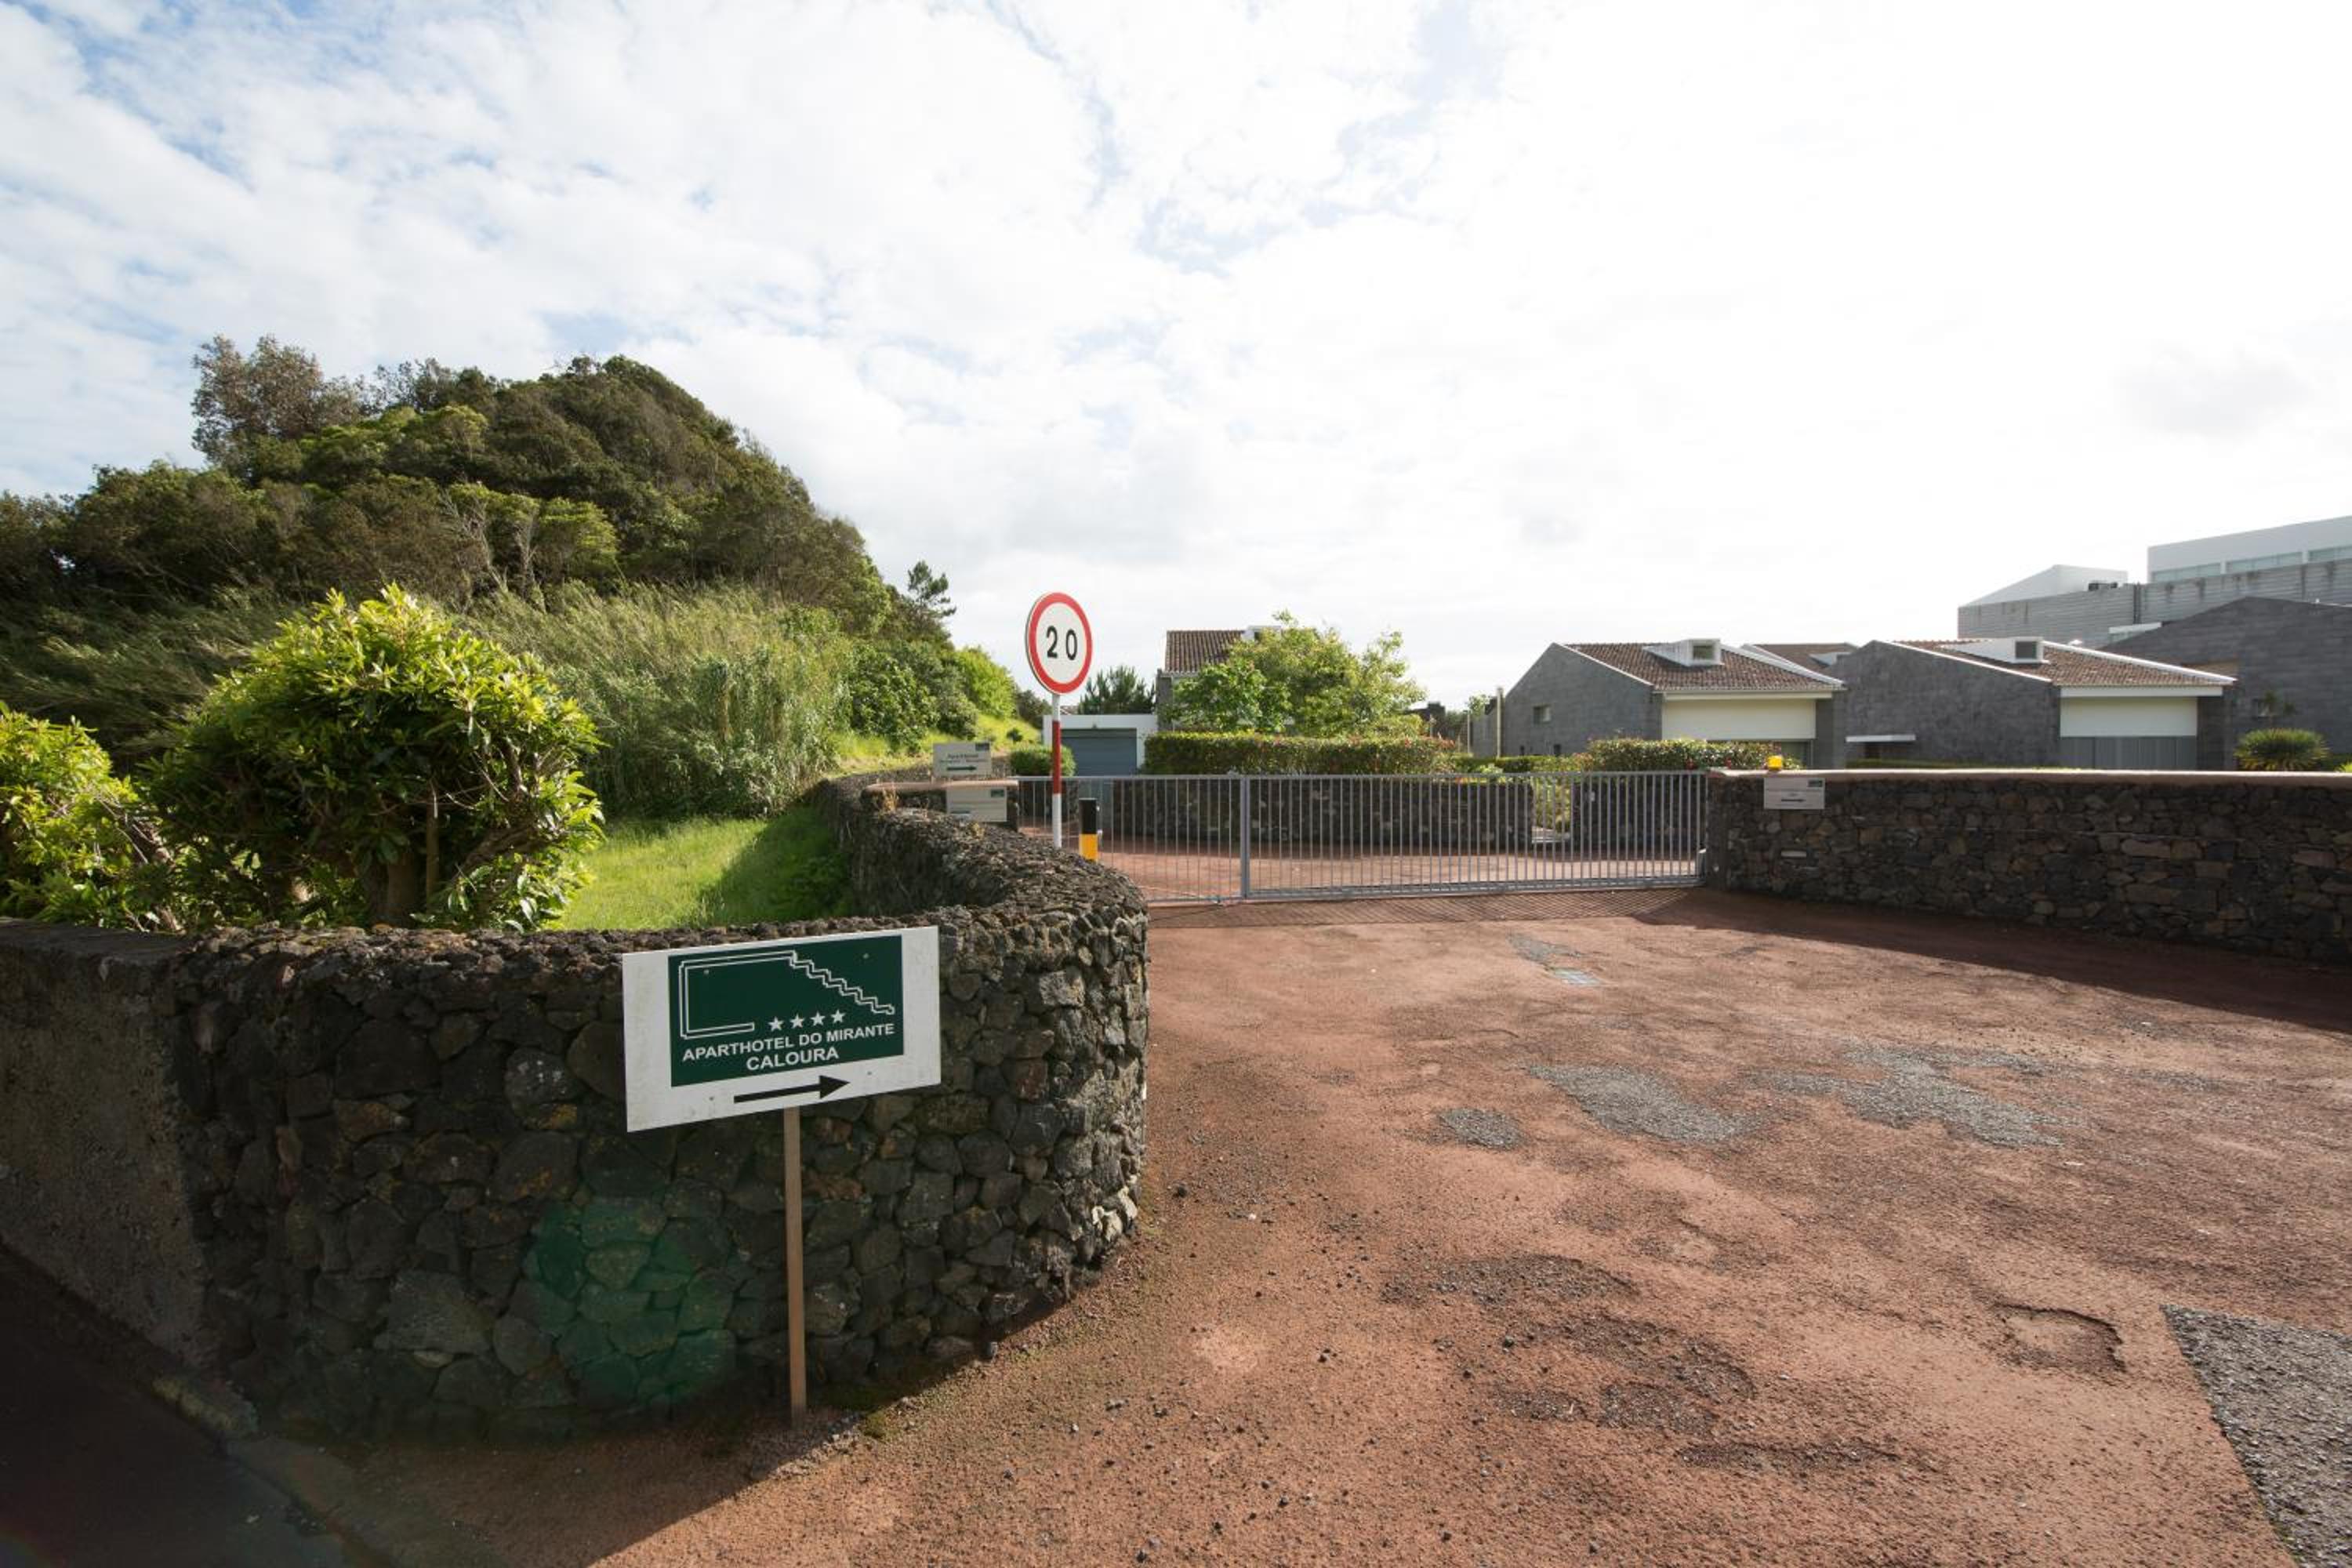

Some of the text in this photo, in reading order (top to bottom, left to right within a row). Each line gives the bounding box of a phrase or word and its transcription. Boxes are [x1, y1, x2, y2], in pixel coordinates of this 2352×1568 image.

[1047, 626, 1077, 660] 20
[683, 1023, 895, 1062] APARTHOTEL DO MIRANTE
[746, 1047, 839, 1070] CALOURA
